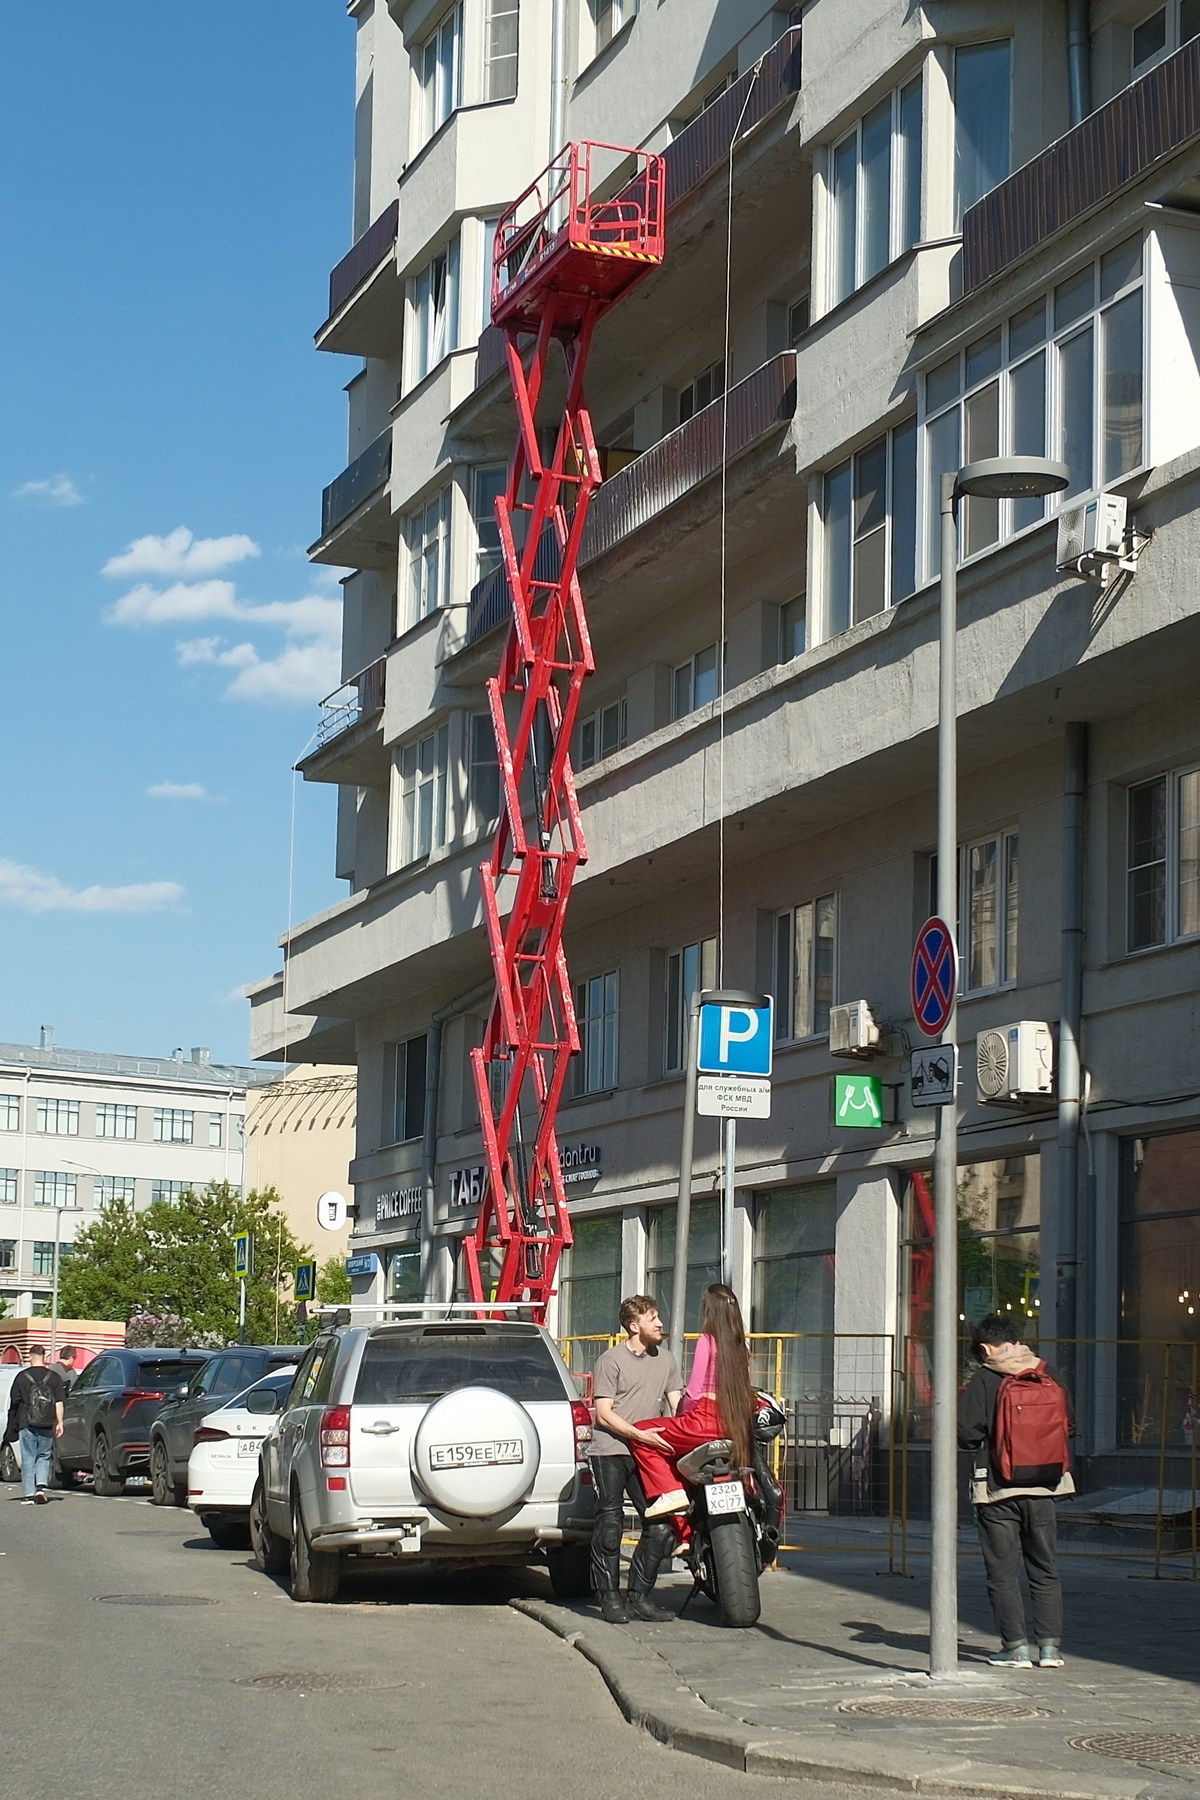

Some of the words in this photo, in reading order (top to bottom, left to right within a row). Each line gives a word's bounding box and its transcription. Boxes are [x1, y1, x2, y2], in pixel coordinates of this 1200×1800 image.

[719, 1006, 758, 1063] P
[714, 1084, 757, 1093] служебных
[758, 1086, 770, 1094] а/м
[716, 1094, 734, 1102] ФСК
[735, 1095, 753, 1104] МВД
[721, 1104, 748, 1112] России
[381, 1190, 399, 1220] PRICE
[399, 1185, 422, 1216] COFFEE
[436, 1446, 493, 1462] Е159ЕЕ
[495, 1441, 517, 1454] 777
[711, 1484, 737, 1495] 2320
[729, 1497, 741, 1507] 77
